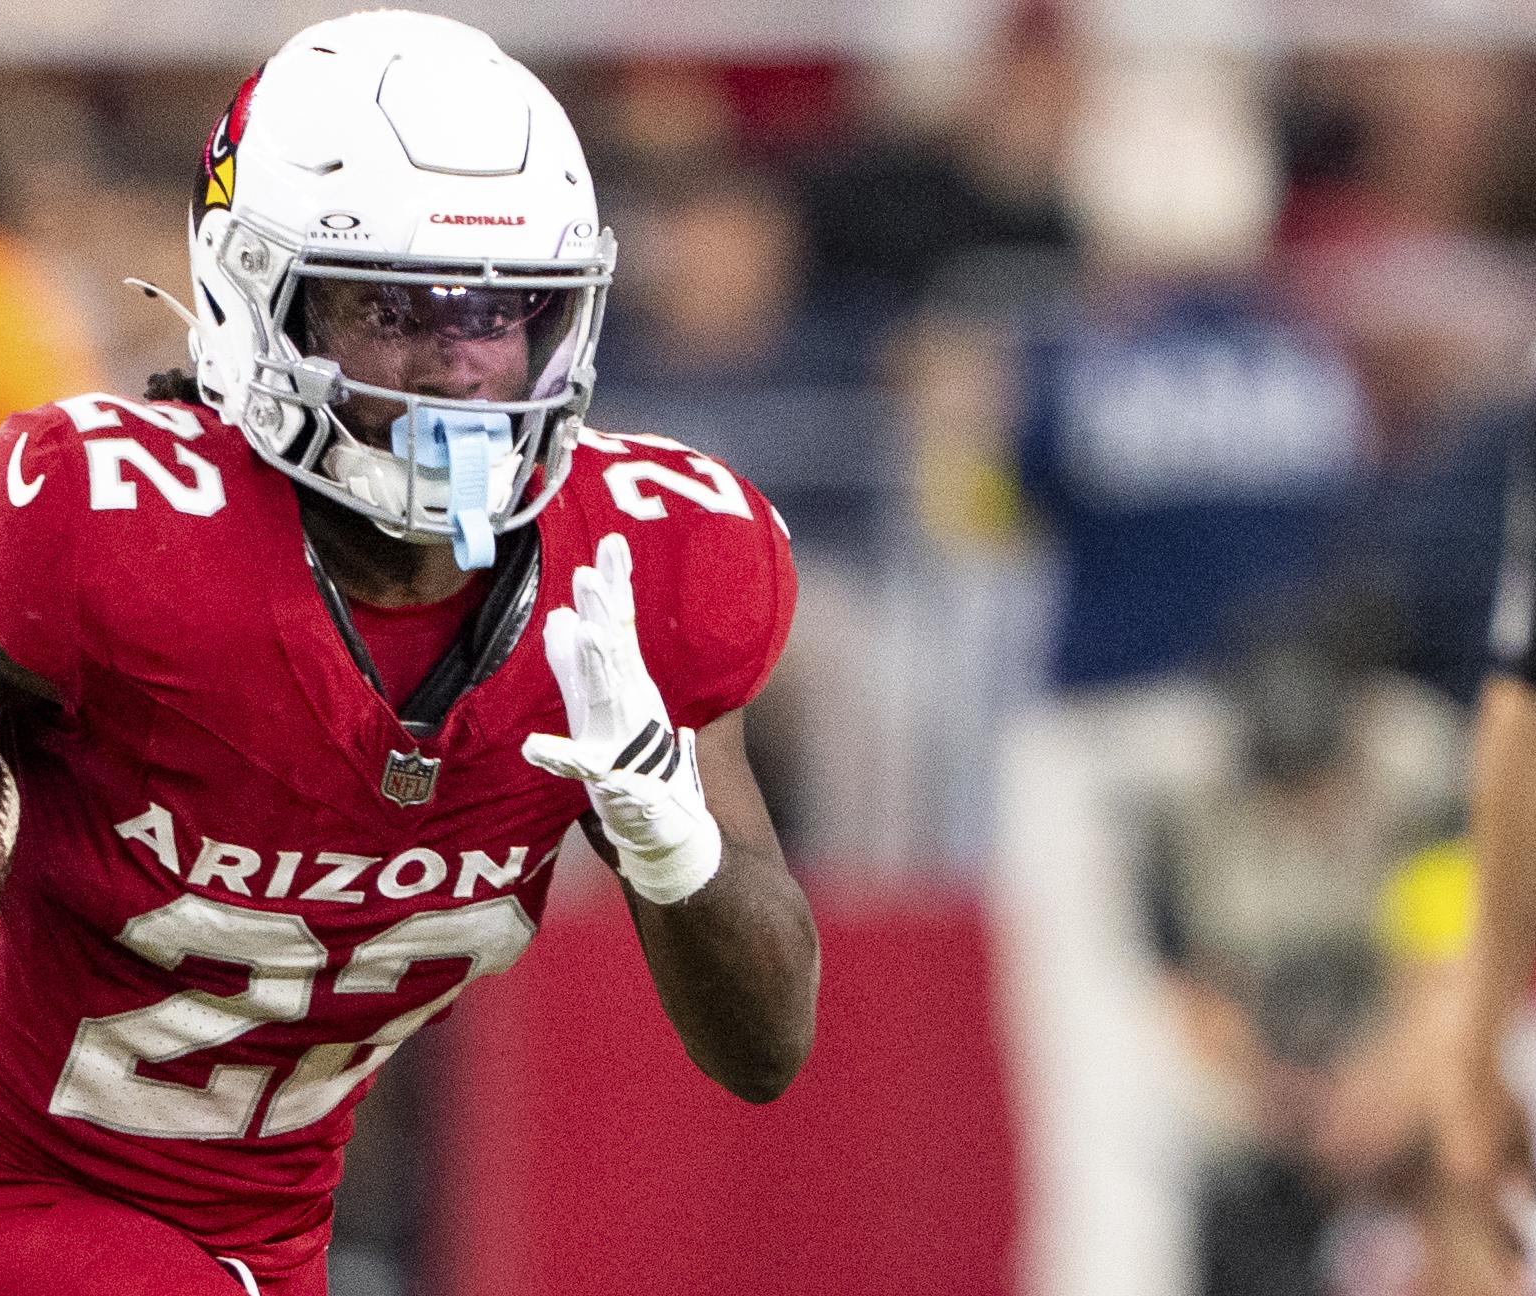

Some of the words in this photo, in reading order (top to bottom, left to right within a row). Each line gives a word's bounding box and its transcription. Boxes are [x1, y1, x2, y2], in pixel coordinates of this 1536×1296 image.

[430, 213, 526, 226] CARDINALS
[55, 391, 228, 518] 22
[387, 771, 431, 798] NFL
[114, 801, 561, 904] ARIZON
[49, 894, 537, 1140] 22
